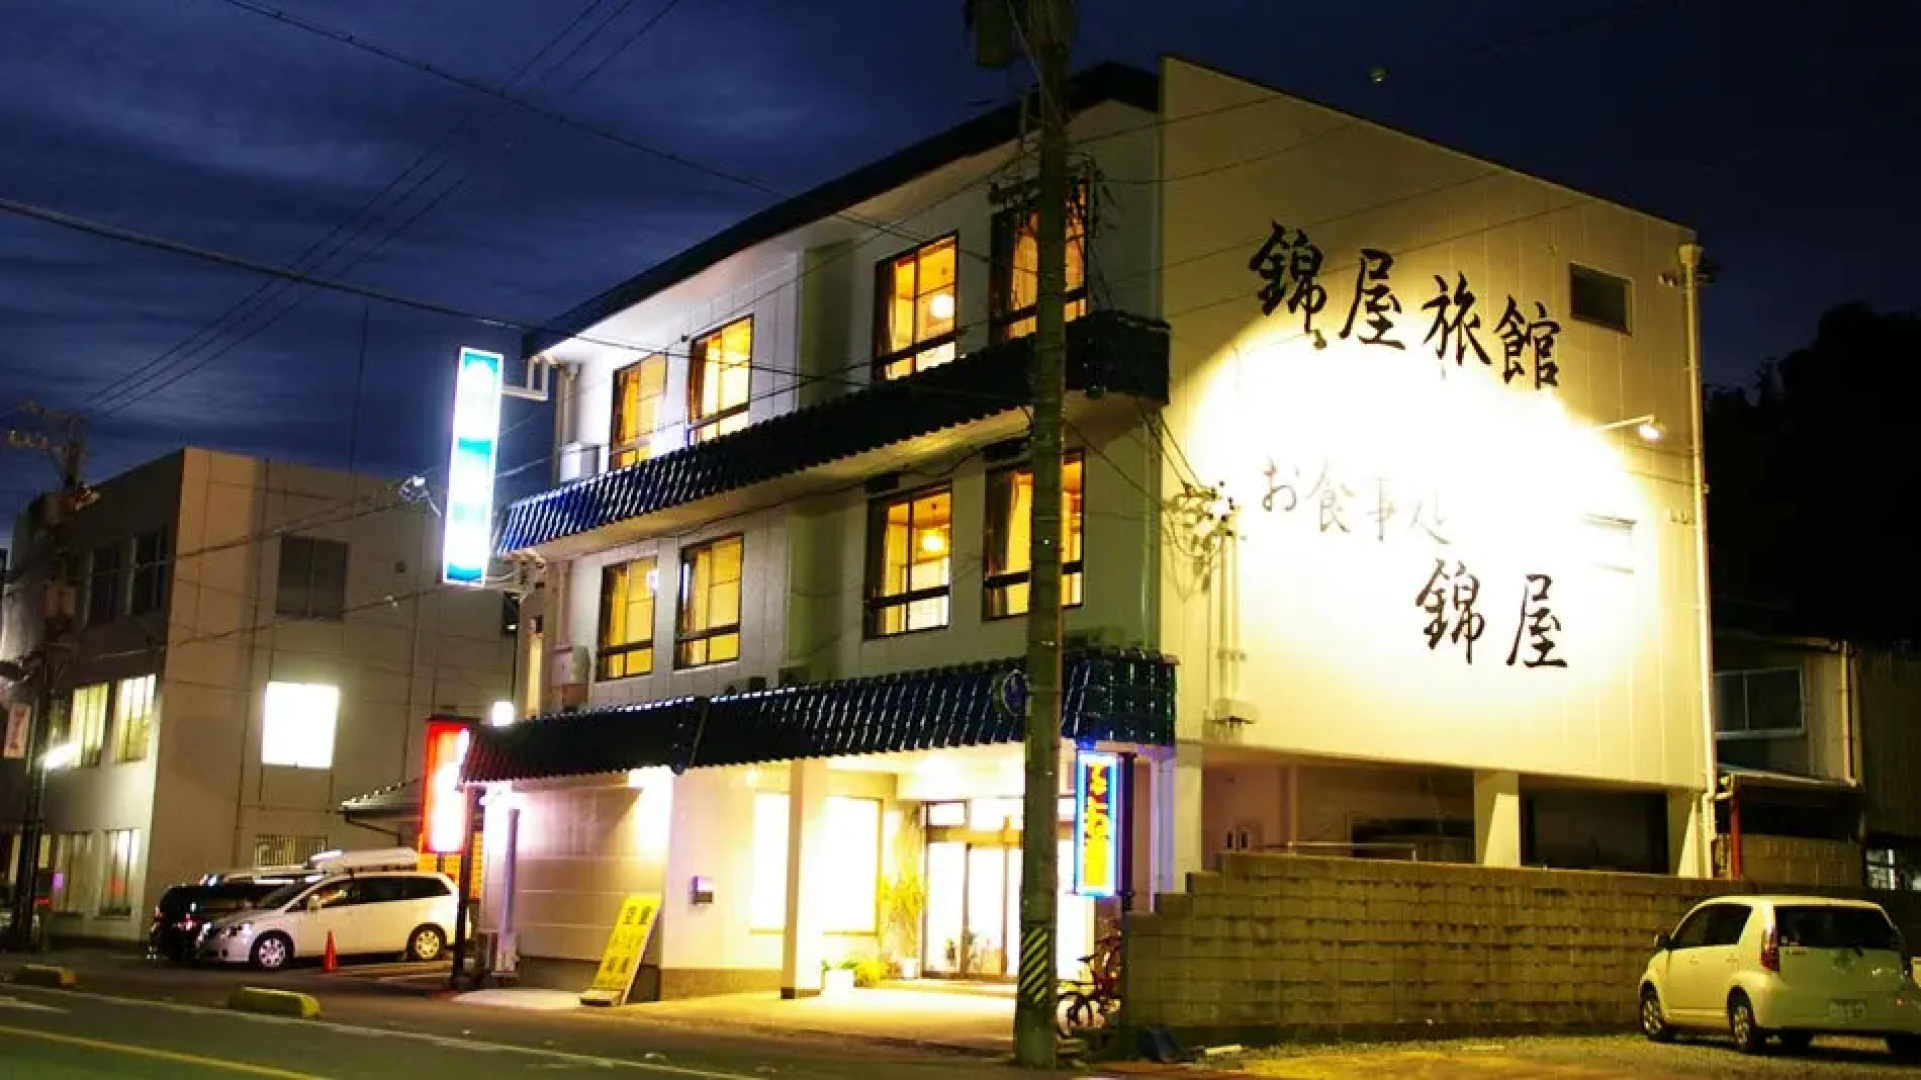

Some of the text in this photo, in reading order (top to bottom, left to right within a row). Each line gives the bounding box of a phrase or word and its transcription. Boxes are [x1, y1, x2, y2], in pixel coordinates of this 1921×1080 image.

[1249, 219, 1562, 390] 錦屋旅館
[1416, 558, 1568, 669] 錦屋
